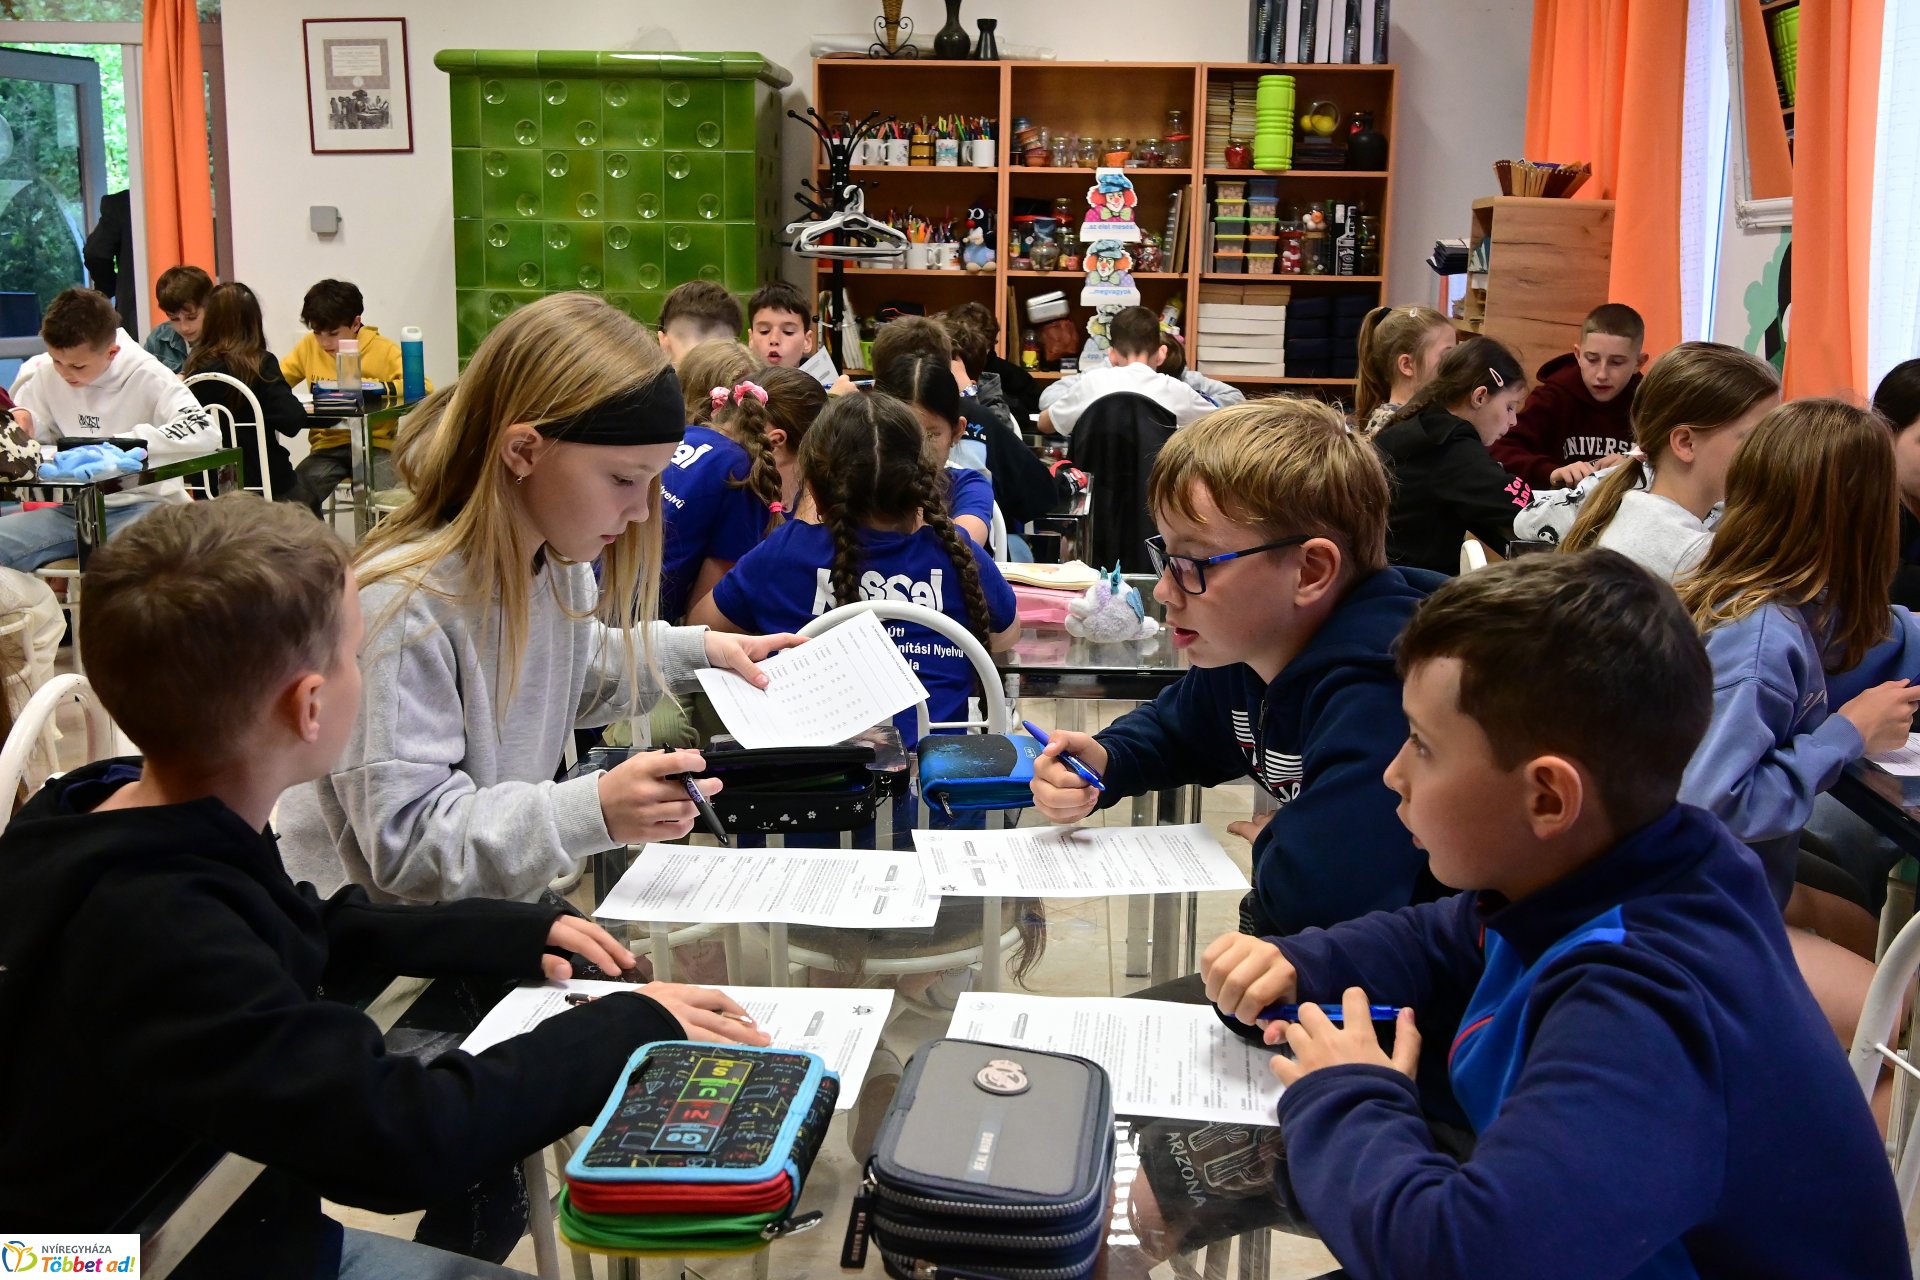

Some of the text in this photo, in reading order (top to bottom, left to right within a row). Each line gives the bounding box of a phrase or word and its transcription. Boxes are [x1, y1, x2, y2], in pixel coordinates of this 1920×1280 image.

[1562, 436, 1638, 460] UNIVERS
[660, 484, 685, 509] yelvű
[898, 642, 931, 655] nítási
[711, 1066, 729, 1076] S
[698, 1087, 718, 1098] U
[1165, 1131, 1208, 1209] ARIZONA
